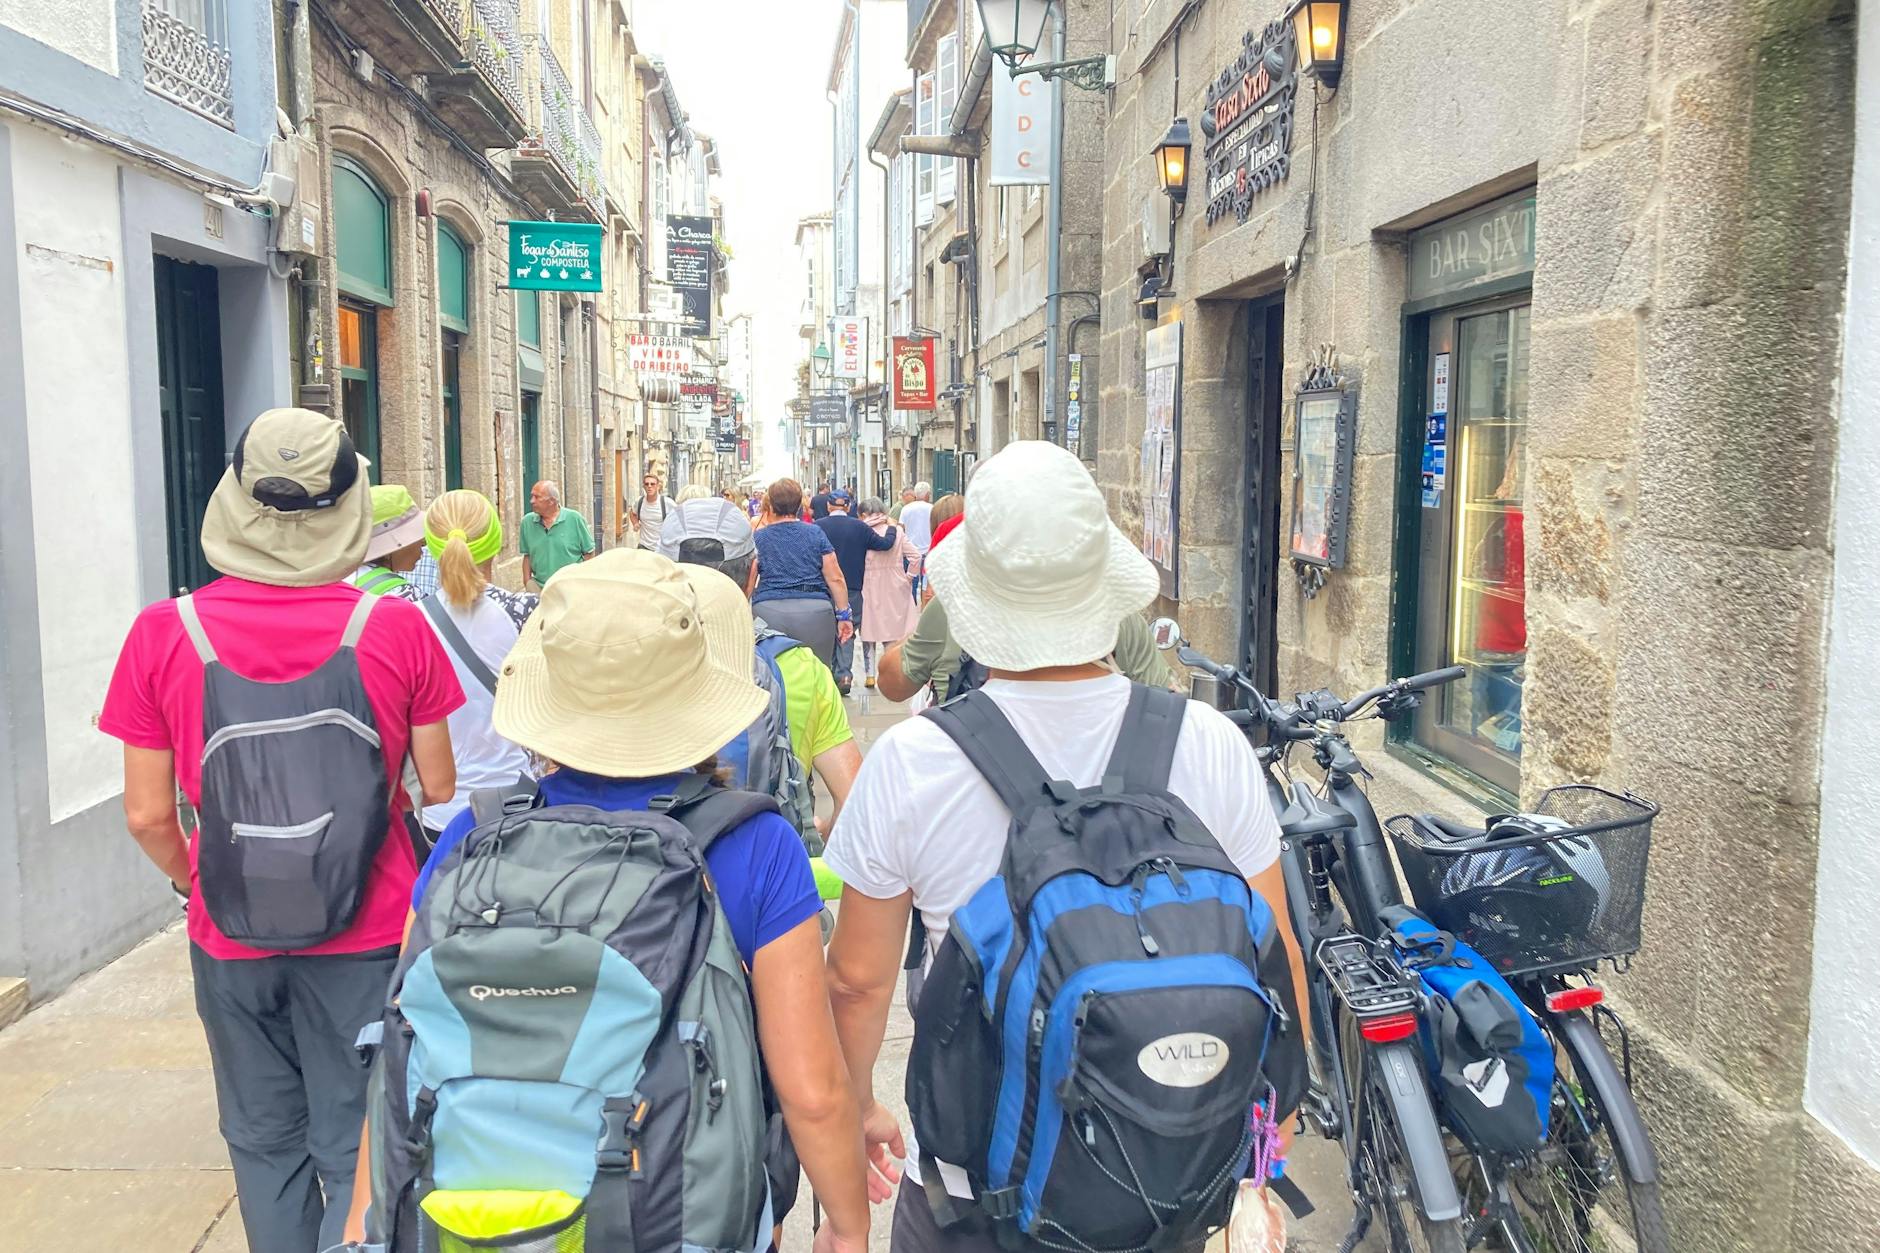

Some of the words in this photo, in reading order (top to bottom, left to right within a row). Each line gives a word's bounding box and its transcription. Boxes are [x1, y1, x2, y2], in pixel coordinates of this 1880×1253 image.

[1215, 90, 1239, 133] Casa
[1241, 61, 1270, 110] Sixto
[1225, 108, 1264, 150] ESPECIALIDAD
[1238, 142, 1247, 160] EN
[520, 233, 548, 264] Fogar
[550, 239, 590, 258] Santiso
[1430, 229, 1470, 279] BAR
[1479, 210, 1535, 265] SIXT
[541, 257, 590, 269] COMPOSTELA
[630, 335, 649, 345] BAR
[651, 336, 657, 346] O
[659, 337, 691, 348] BARRIL
[642, 347, 680, 360] VIÑOS
[633, 360, 646, 370] DO
[649, 361, 689, 372] RIBEIRO
[845, 358, 857, 371] EL
[469, 985, 577, 1001] Quechua
[1154, 1041, 1219, 1061] WILD
